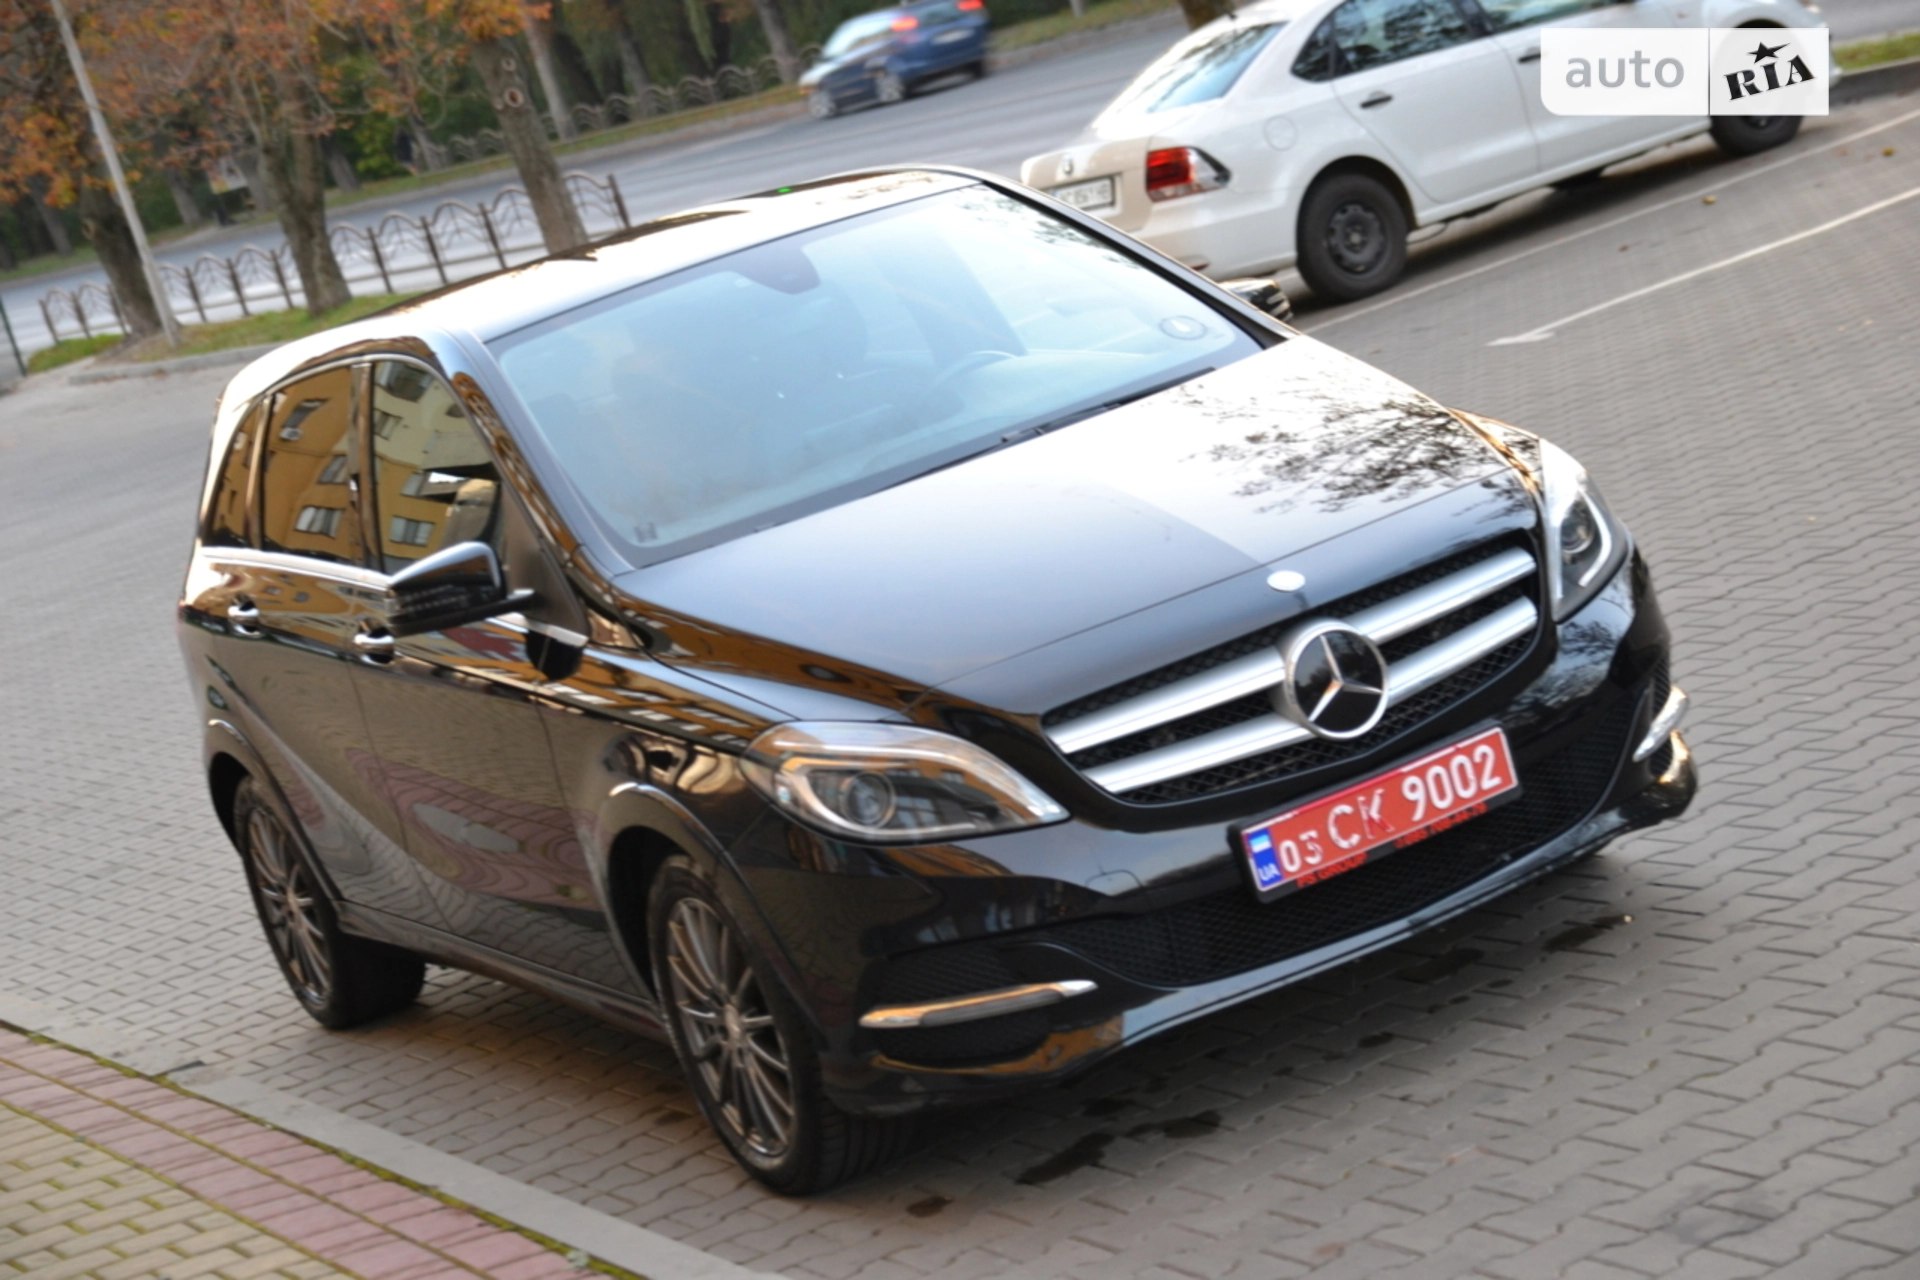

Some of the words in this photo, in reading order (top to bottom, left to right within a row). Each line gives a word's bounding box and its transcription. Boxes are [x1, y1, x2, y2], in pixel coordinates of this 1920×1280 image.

[1327, 788, 1395, 850] CK
[1401, 744, 1502, 822] 9002
[1257, 863, 1281, 882] UA
